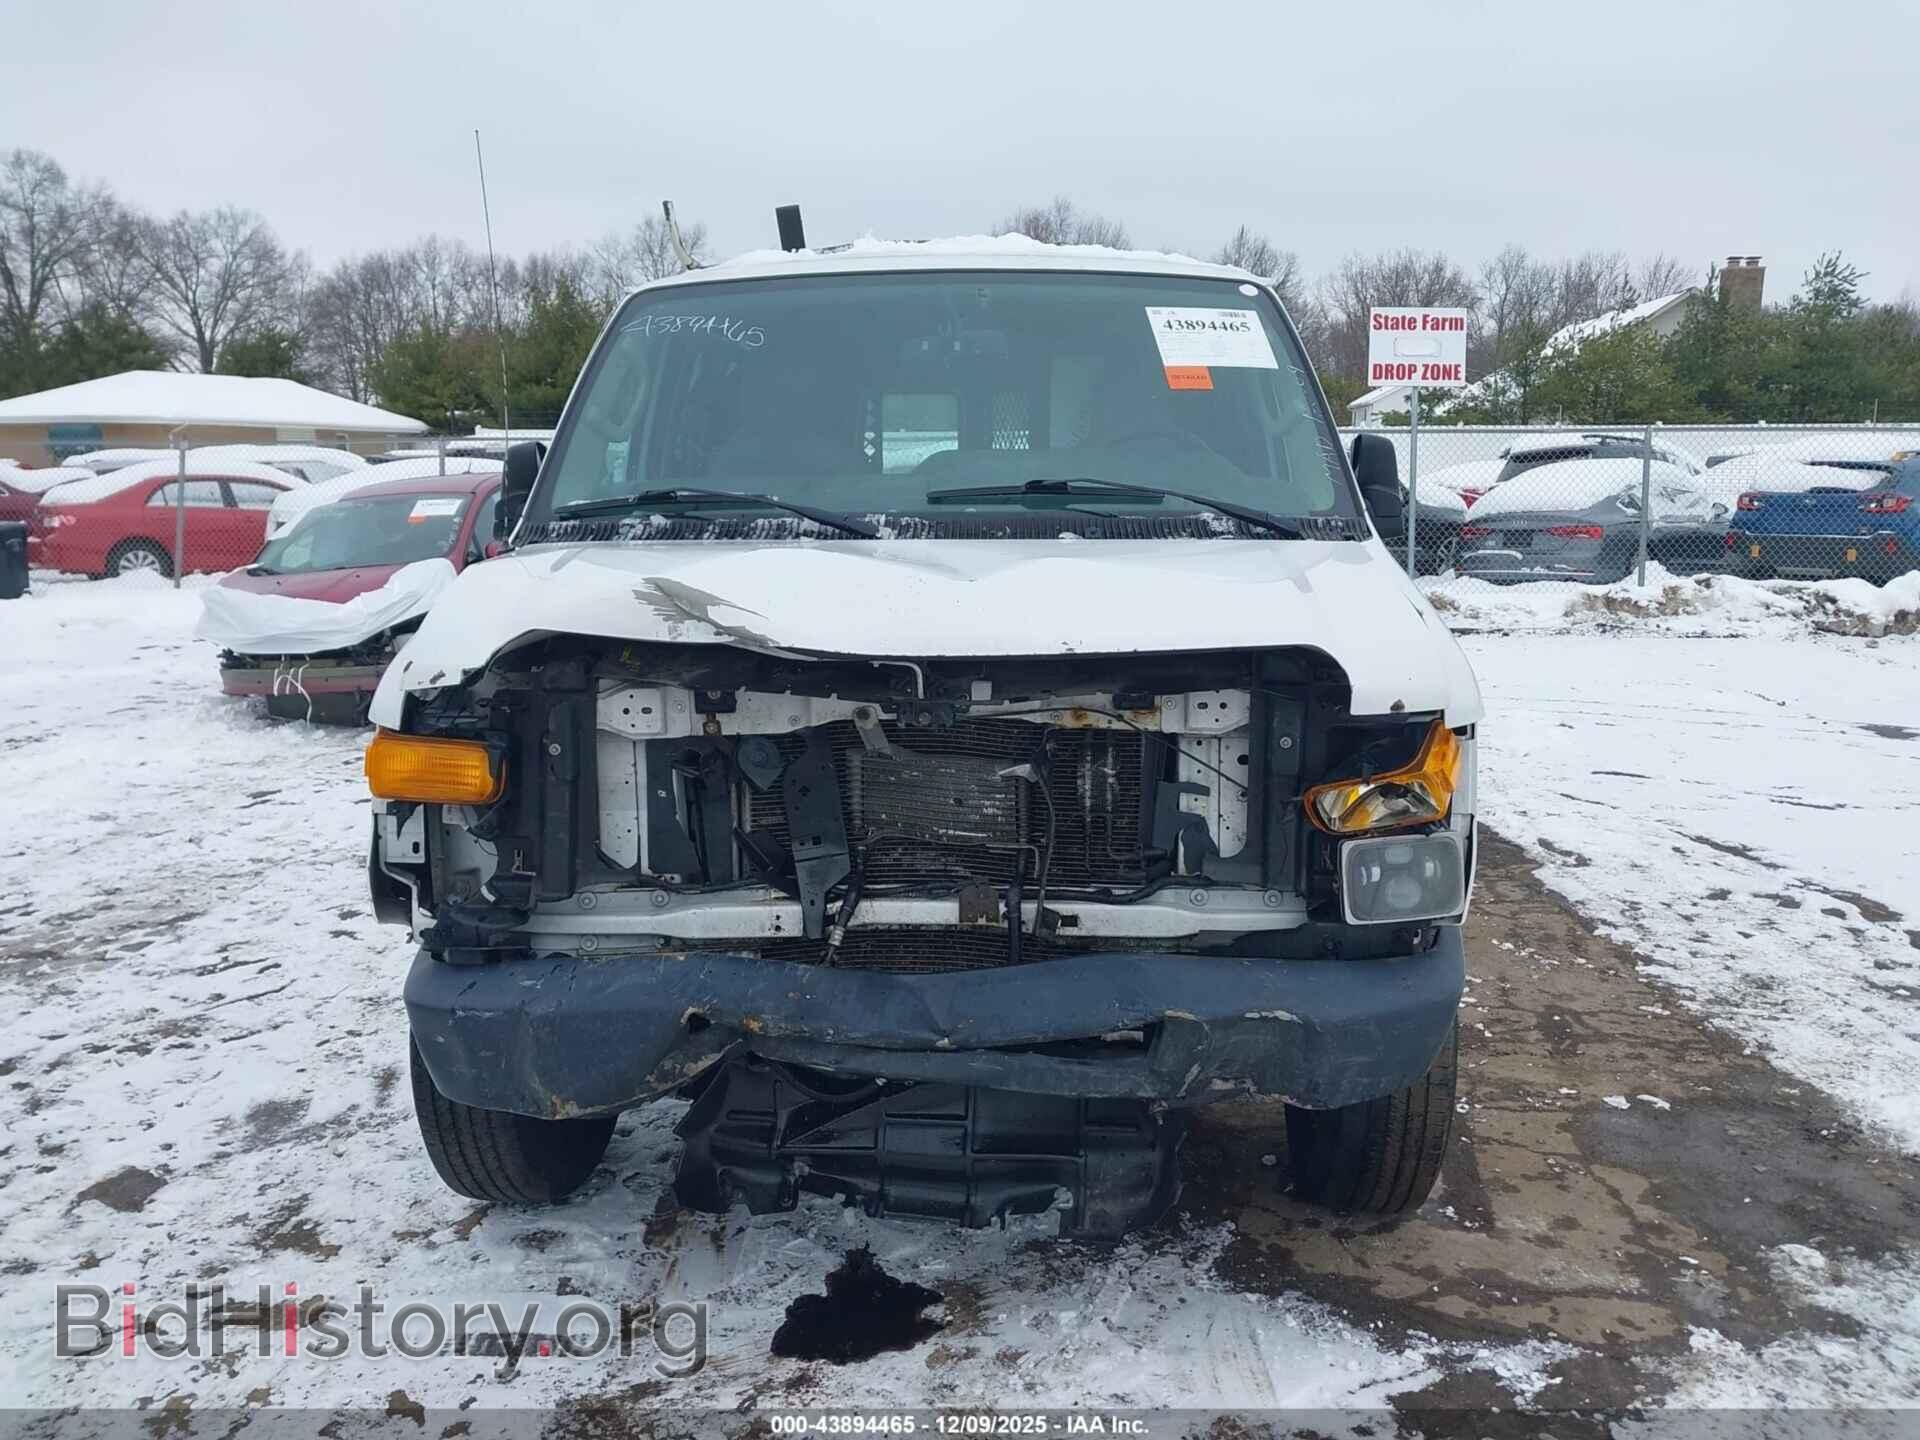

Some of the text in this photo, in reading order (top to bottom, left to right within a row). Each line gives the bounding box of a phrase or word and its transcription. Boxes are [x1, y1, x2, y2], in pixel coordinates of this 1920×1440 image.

[1163, 318, 1252, 333] 43894465
[1372, 312, 1465, 332] State Farm
[1372, 363, 1463, 381] DROP ZONE
